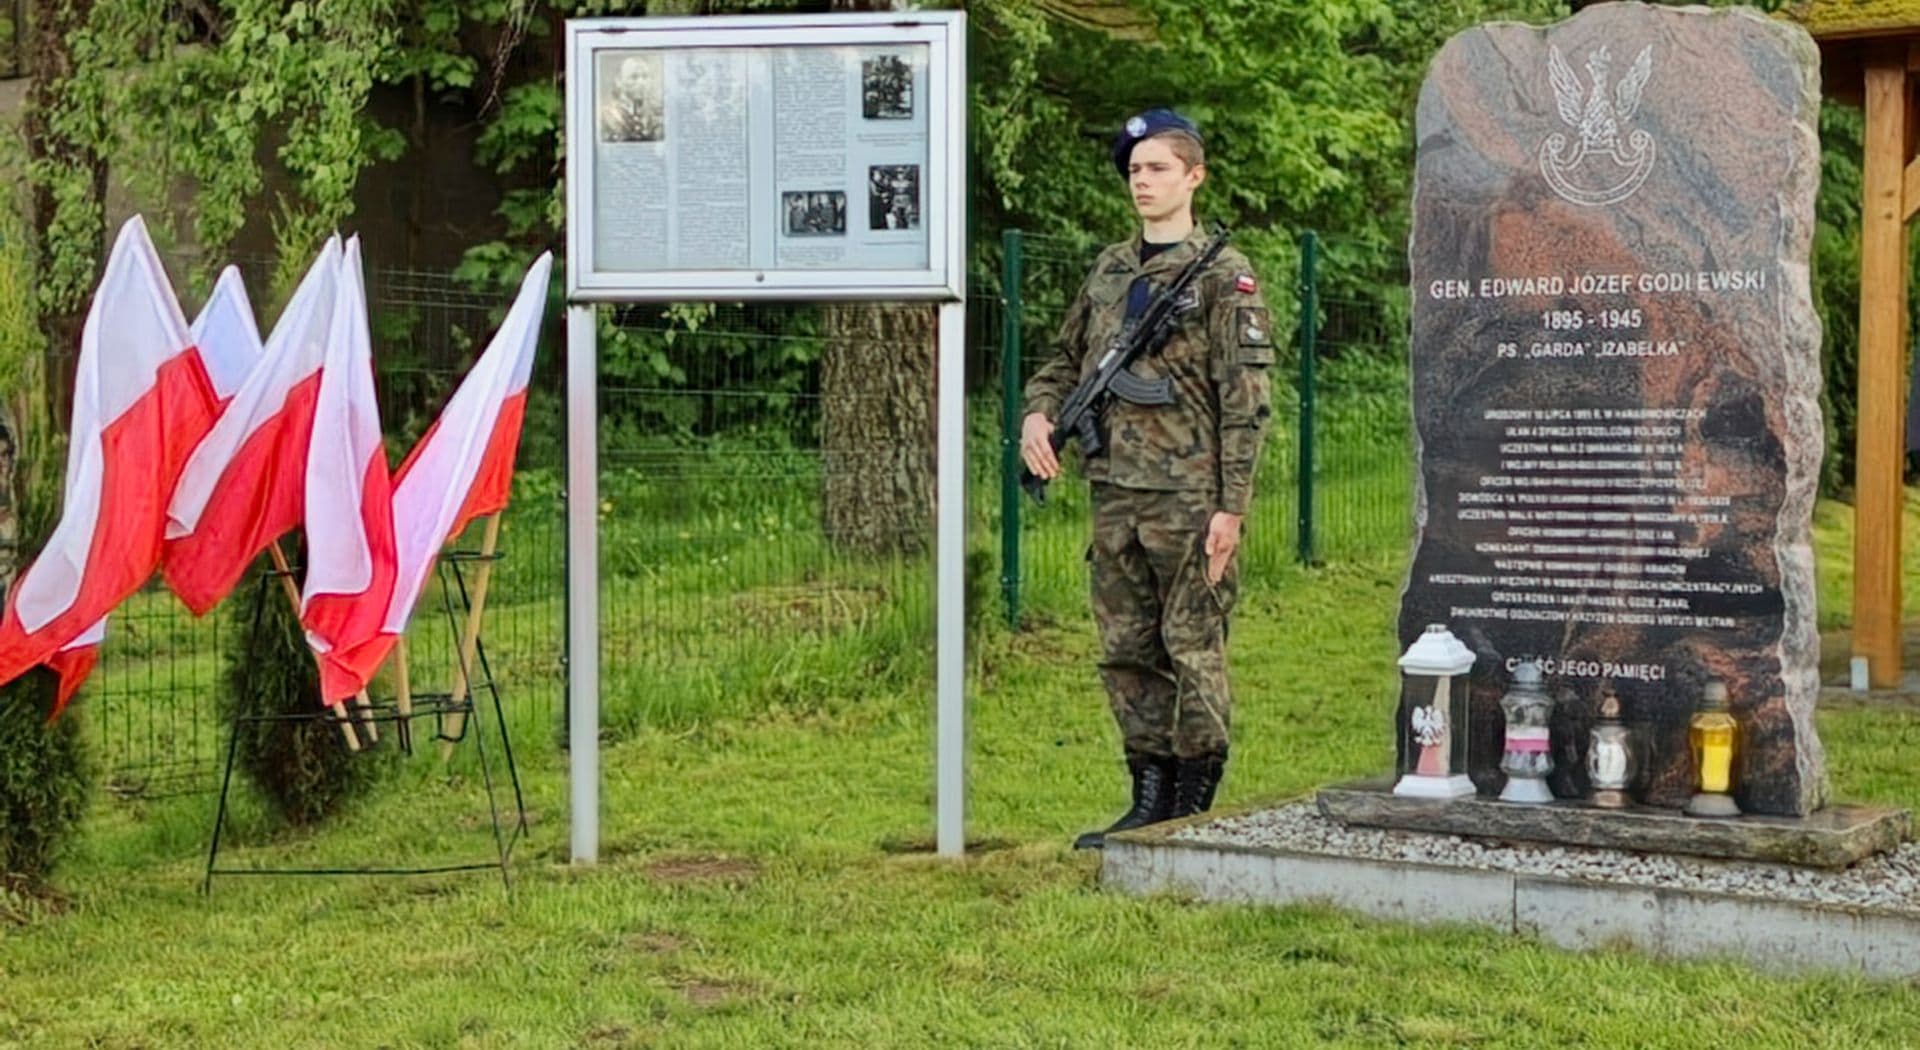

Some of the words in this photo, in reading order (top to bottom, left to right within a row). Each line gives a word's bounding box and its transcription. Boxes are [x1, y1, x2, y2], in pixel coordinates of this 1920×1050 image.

[1430, 280, 1475, 299] GEN.
[1480, 276, 1564, 297] EDWARD
[1542, 311, 1582, 330] 1895
[1600, 309, 1642, 328] 1945
[1558, 659, 1600, 676] JEGO
[1602, 662, 1666, 682] PAMIĘCI
